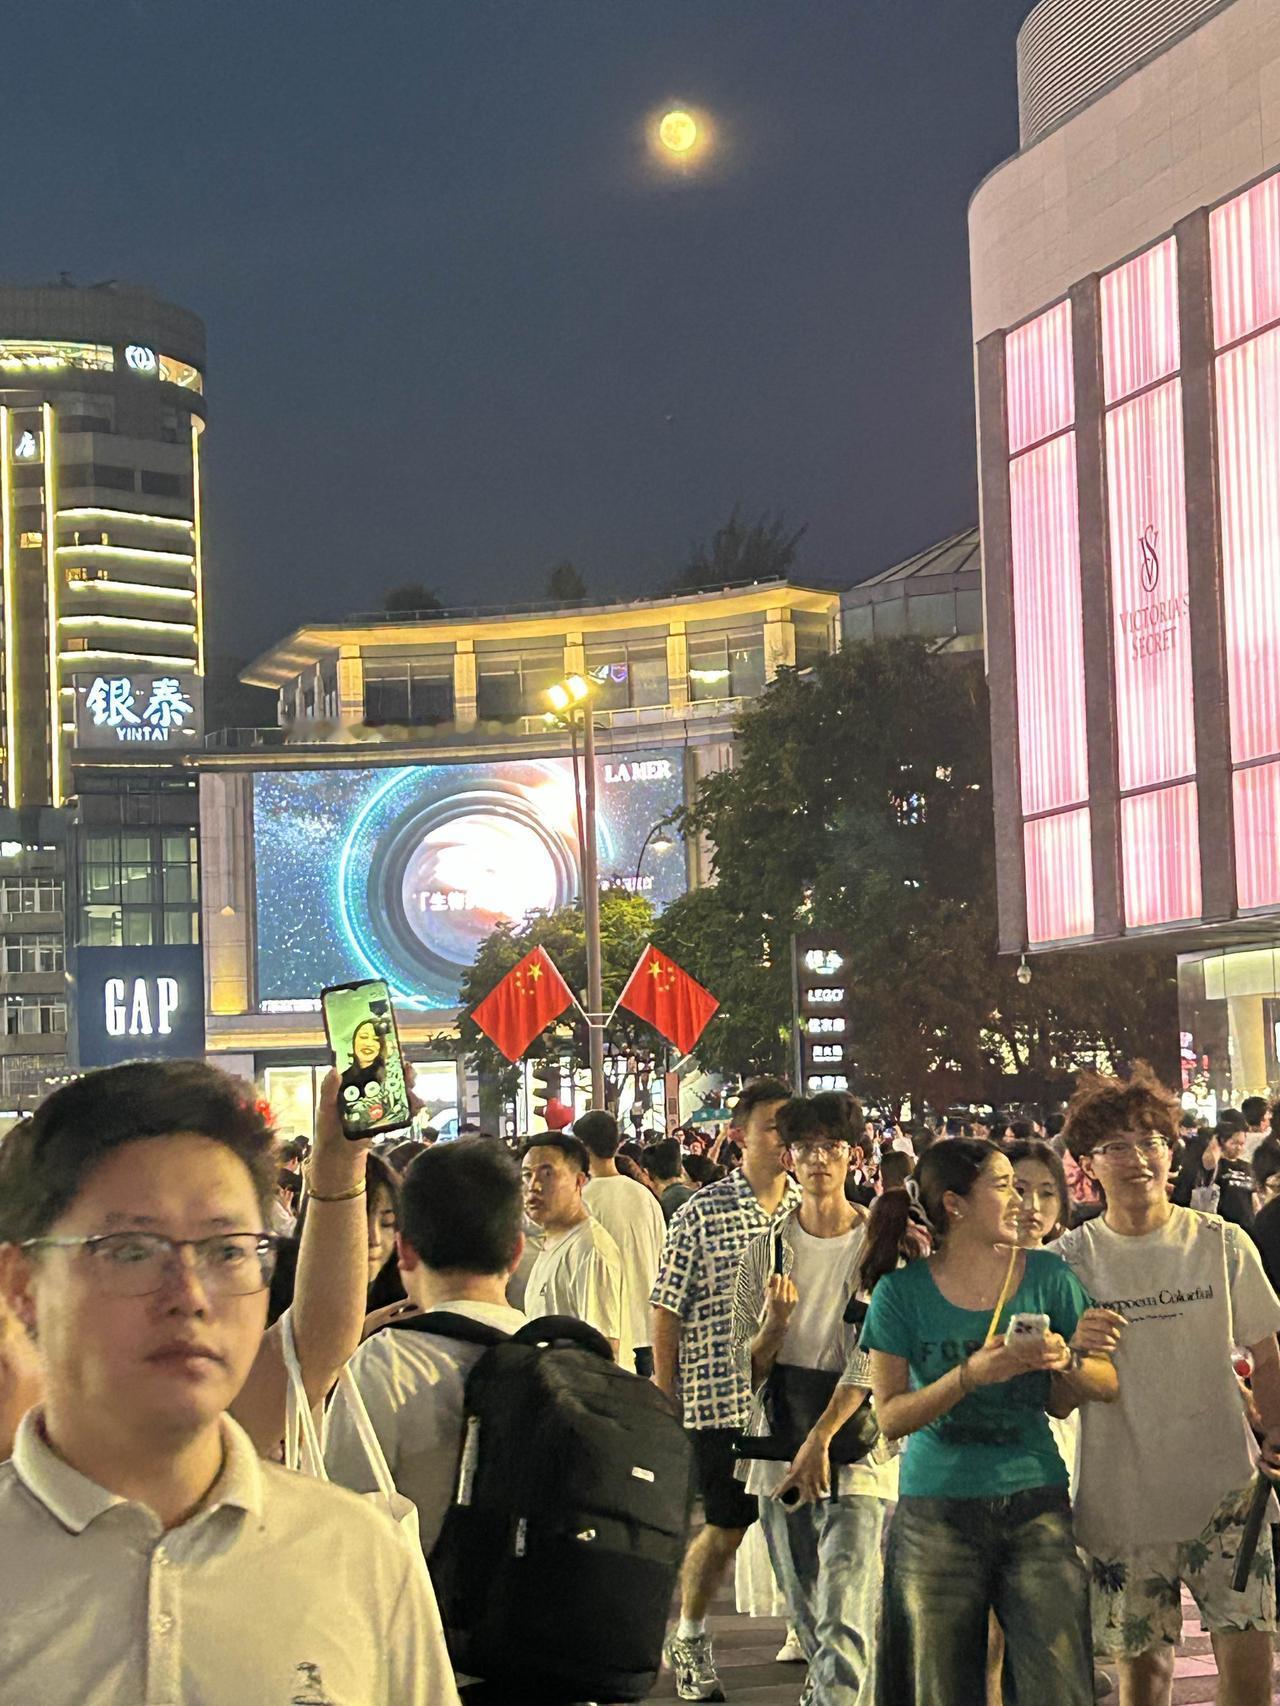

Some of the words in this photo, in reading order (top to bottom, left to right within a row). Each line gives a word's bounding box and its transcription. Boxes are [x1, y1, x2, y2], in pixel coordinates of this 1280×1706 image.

[1132, 626, 1177, 661] SECRET
[86, 677, 194, 727] 银泰
[116, 726, 168, 741] YINTAI
[104, 977, 179, 1036] GAP
[807, 988, 844, 1002] LEGO
